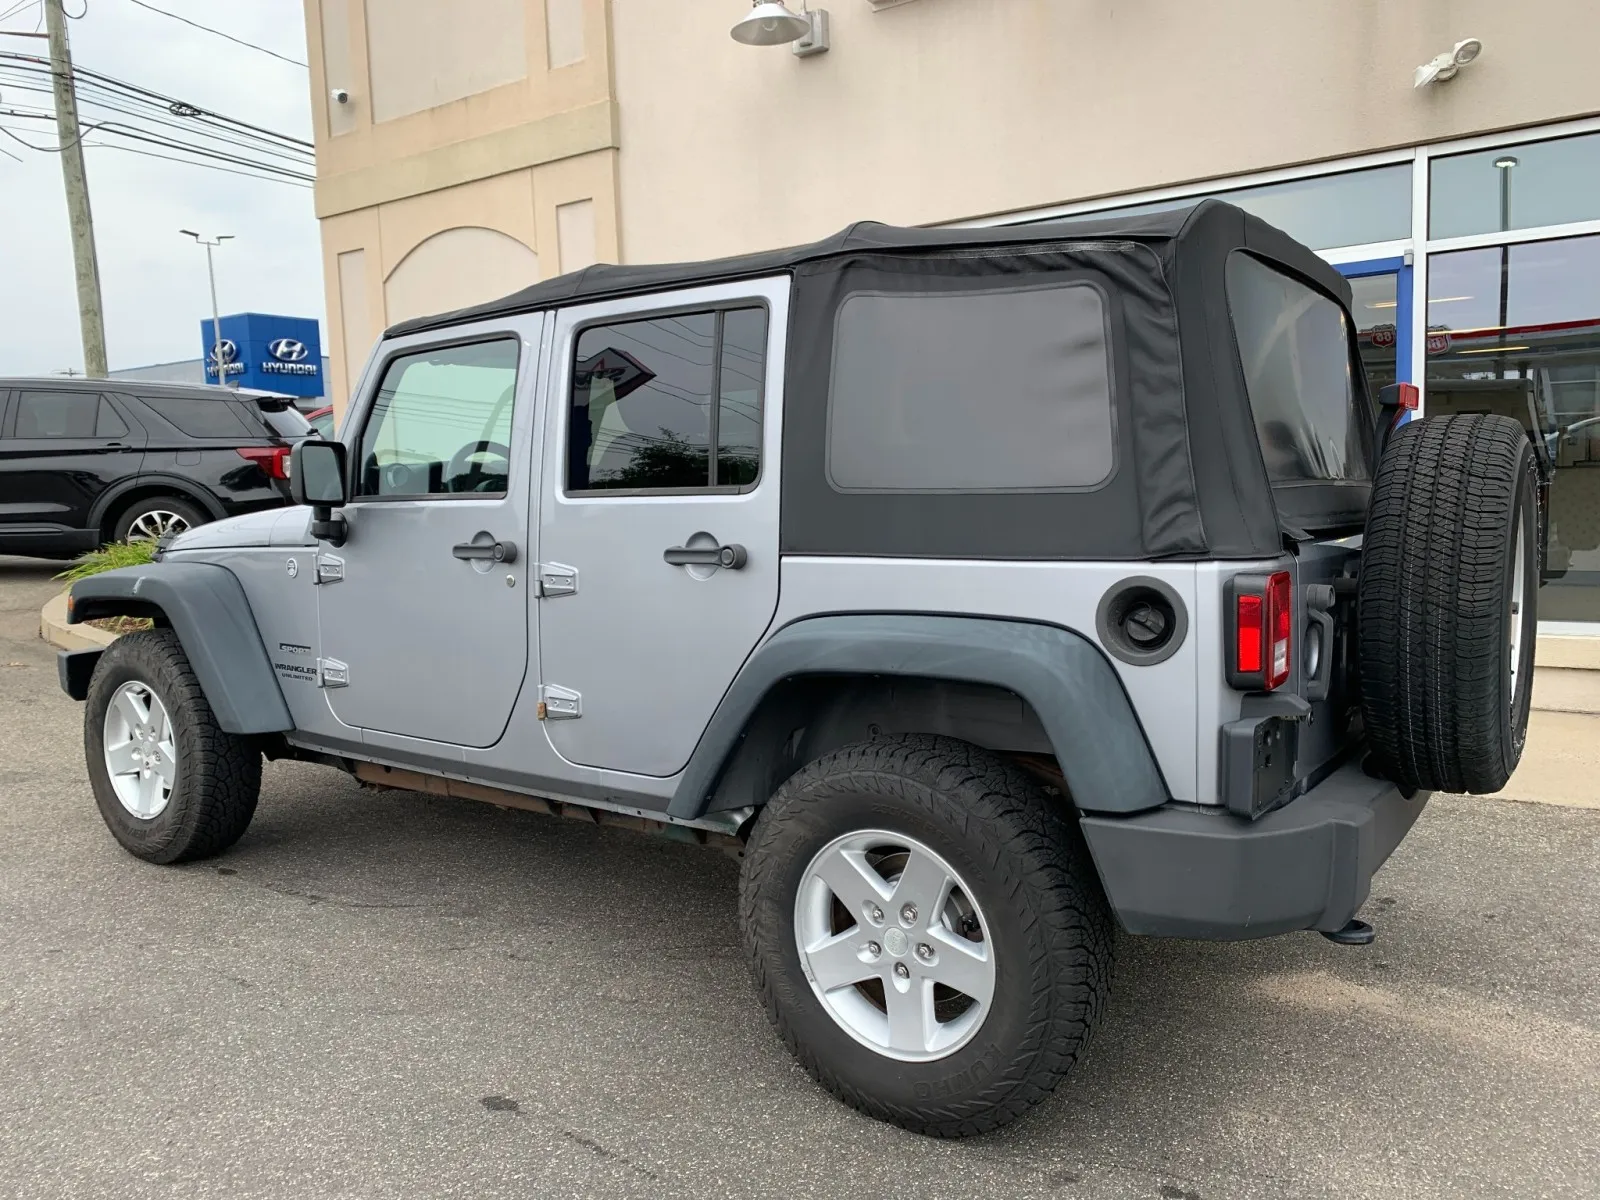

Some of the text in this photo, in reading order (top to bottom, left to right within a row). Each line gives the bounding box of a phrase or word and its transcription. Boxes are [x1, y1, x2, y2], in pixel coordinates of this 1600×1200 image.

[206, 361, 245, 377] HYNDAI
[262, 361, 317, 376] HYUNDAI
[274, 662, 317, 676] WRANGLER
[281, 672, 313, 682] UNLIMITED
